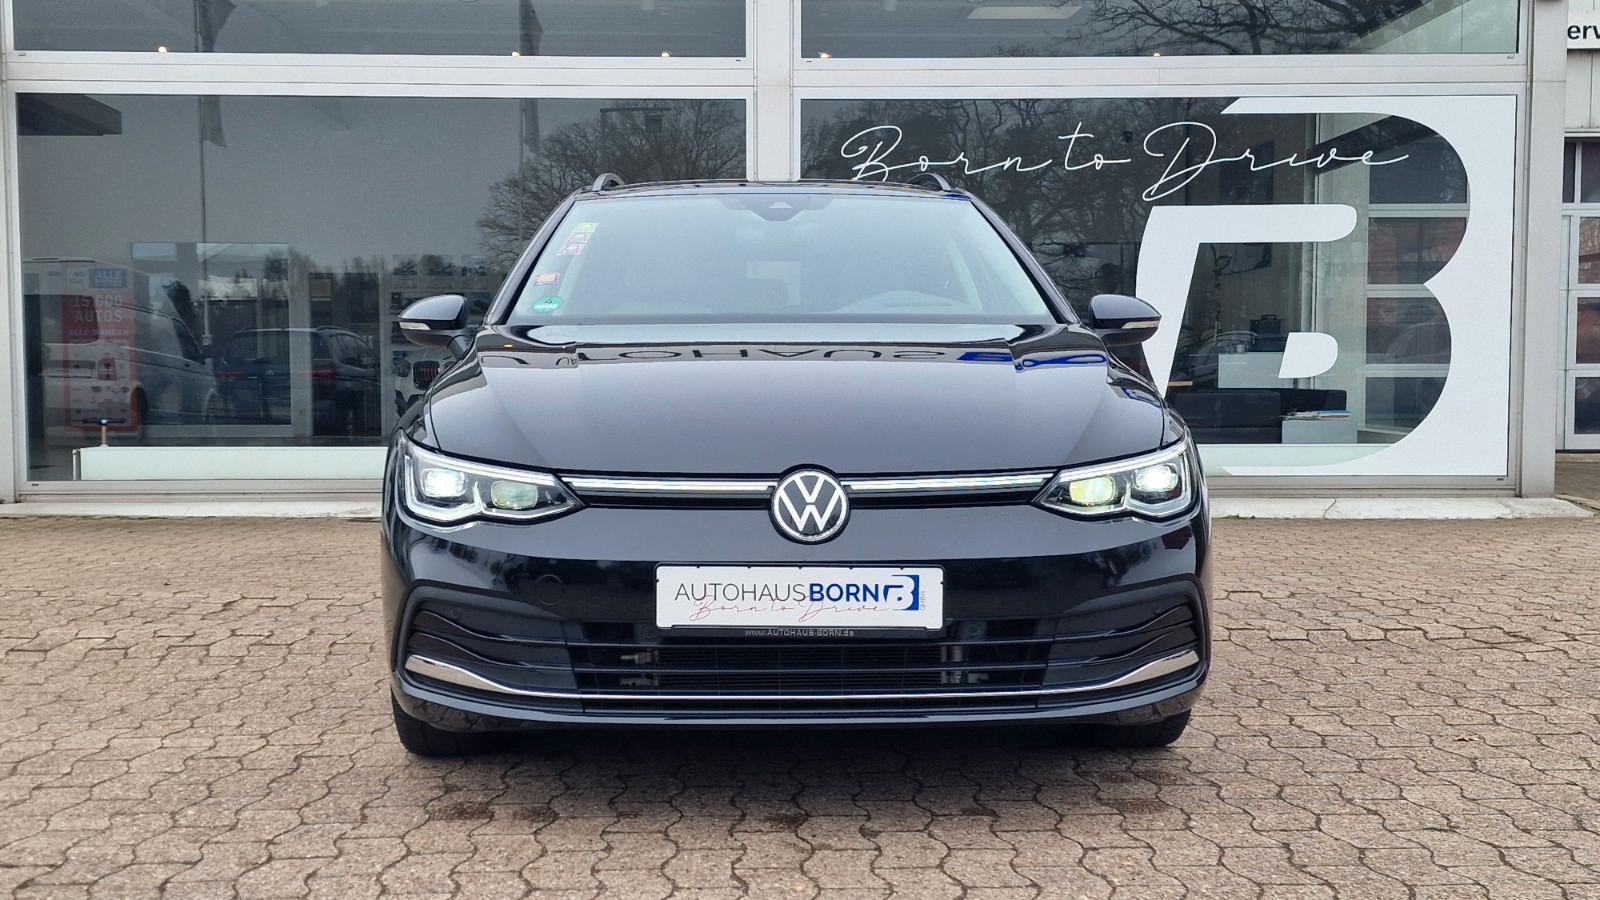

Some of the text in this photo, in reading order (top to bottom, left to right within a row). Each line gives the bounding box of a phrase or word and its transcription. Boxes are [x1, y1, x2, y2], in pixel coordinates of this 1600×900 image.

[840, 121, 1410, 202] Born to Drive
[73, 309, 124, 323] AUTOS
[688, 595, 767, 622] Born
